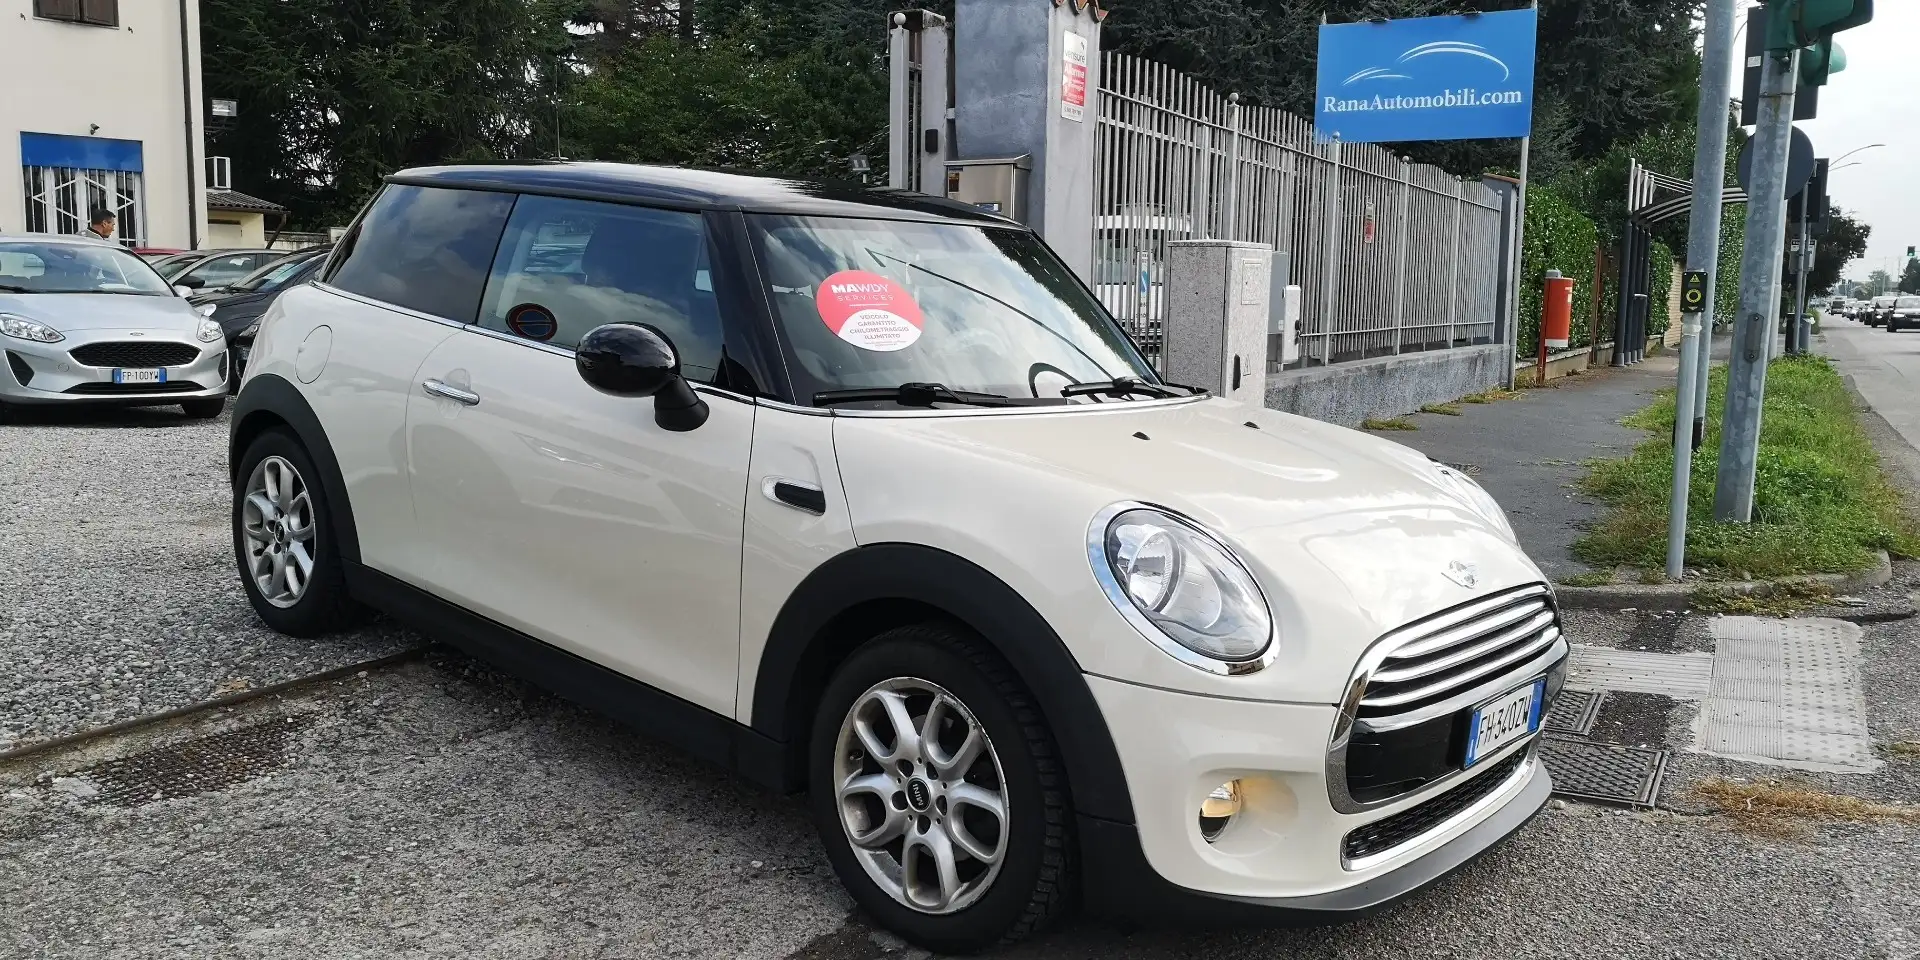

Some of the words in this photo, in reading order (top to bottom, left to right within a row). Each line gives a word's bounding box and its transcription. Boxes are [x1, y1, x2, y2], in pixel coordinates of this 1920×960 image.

[1323, 88, 1522, 113] RanaAutomobili.com
[831, 283, 889, 294] MAWDY
[850, 326, 910, 335] CHILOMETRAGGIO
[912, 783, 924, 806] MINI
